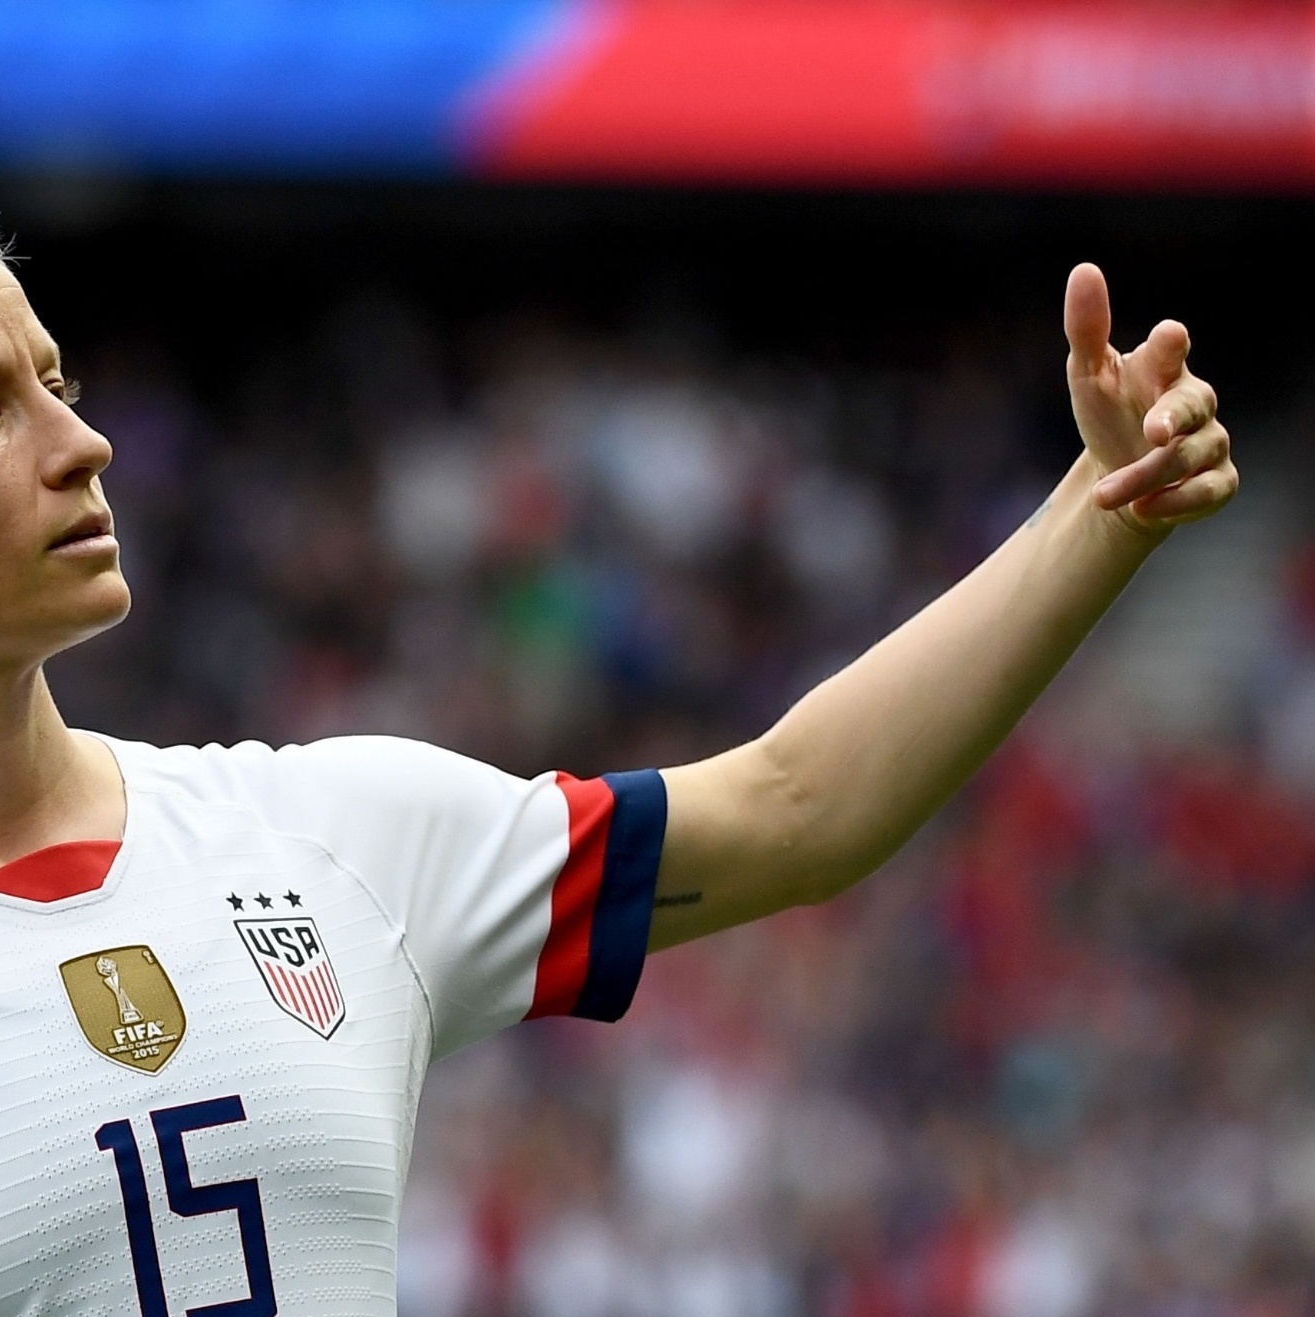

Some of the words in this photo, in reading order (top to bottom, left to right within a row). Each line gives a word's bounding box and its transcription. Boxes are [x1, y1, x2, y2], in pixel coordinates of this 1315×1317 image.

[246, 926, 320, 967] USA
[107, 1043, 135, 1054] WORLD
[135, 1034, 179, 1048] CHAMPIONS
[132, 1045, 160, 1059] 2015
